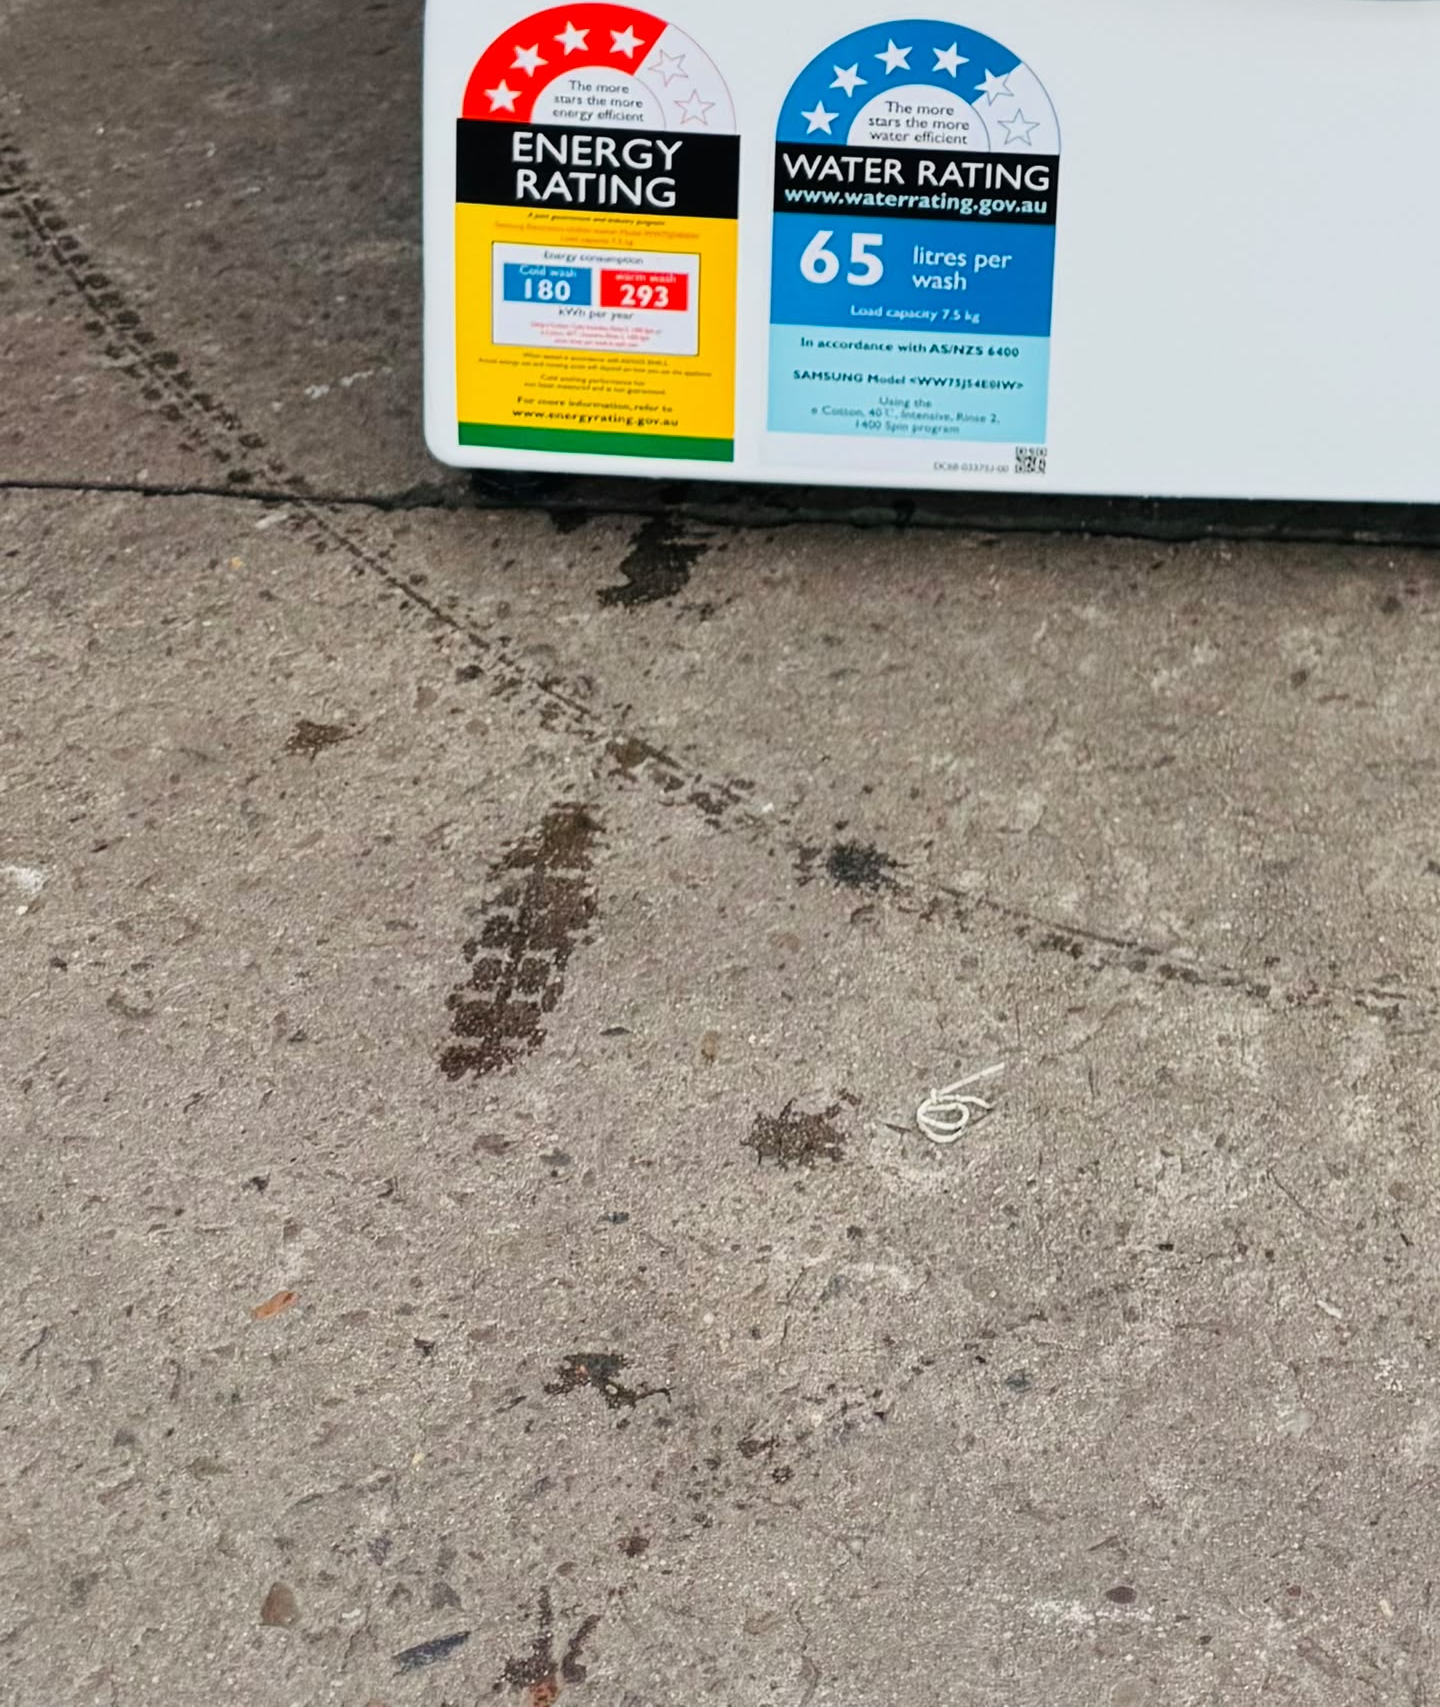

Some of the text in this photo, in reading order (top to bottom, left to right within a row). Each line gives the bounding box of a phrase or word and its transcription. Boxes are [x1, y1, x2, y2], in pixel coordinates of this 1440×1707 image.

[568, 79, 629, 94] The more
[553, 94, 643, 109] stars the more
[885, 101, 954, 116] The more
[552, 109, 644, 123] energy efficient
[868, 116, 969, 131] stars the more
[870, 131, 968, 145] water efficient
[511, 131, 683, 170] ENERGY
[782, 153, 1050, 192] WATER RATING
[515, 168, 677, 207] RATING
[784, 188, 1047, 216] www.waterrating.gov.au
[544, 250, 643, 265] Energy consumption
[800, 230, 884, 286] 65
[913, 245, 1012, 272] litres per
[519, 265, 577, 278] Cold wash
[912, 271, 967, 291] wash
[523, 278, 571, 301] 180
[620, 284, 670, 308] 293
[558, 307, 635, 322] kWh per year
[850, 304, 980, 324] Load capacity 7.5 kg
[801, 337, 1020, 358] In accordance with AS/NZS 6400
[793, 369, 863, 383] SAMSUNG
[867, 373, 906, 385] Model
[537, 398, 565, 407] more
[879, 396, 932, 409] Using the
[512, 408, 679, 427] www.energyrating.gov.au
[912, 423, 960, 436] program
